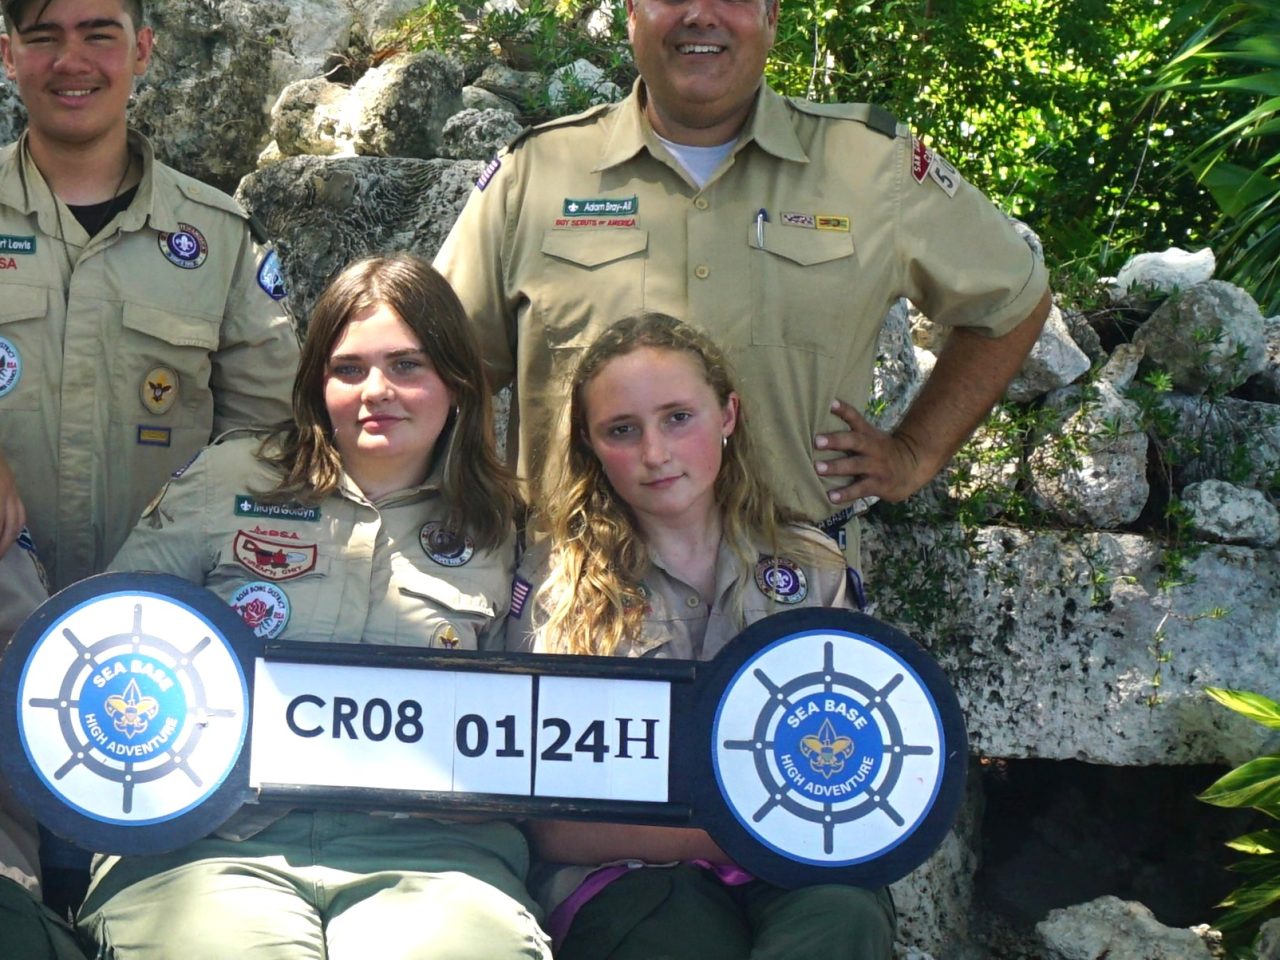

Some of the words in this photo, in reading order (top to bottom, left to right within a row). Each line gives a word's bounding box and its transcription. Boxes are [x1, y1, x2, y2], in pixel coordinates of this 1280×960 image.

[555, 219, 569, 227] BOY
[571, 219, 597, 227] SCOUTS
[607, 218, 636, 227] AMERICA
[583, 202, 605, 212] Adam
[8, 238, 31, 250] Lewis
[92, 661, 128, 688] SEA
[130, 659, 175, 693] BASE
[285, 693, 425, 744] CR08
[455, 713, 525, 759] 01
[786, 700, 821, 729] SEA
[824, 699, 869, 731] BASE
[84, 712, 109, 746] HIGH
[105, 716, 179, 757] ADVENTURE
[780, 753, 806, 787] HIGH
[803, 755, 875, 797] ADVENTURE
